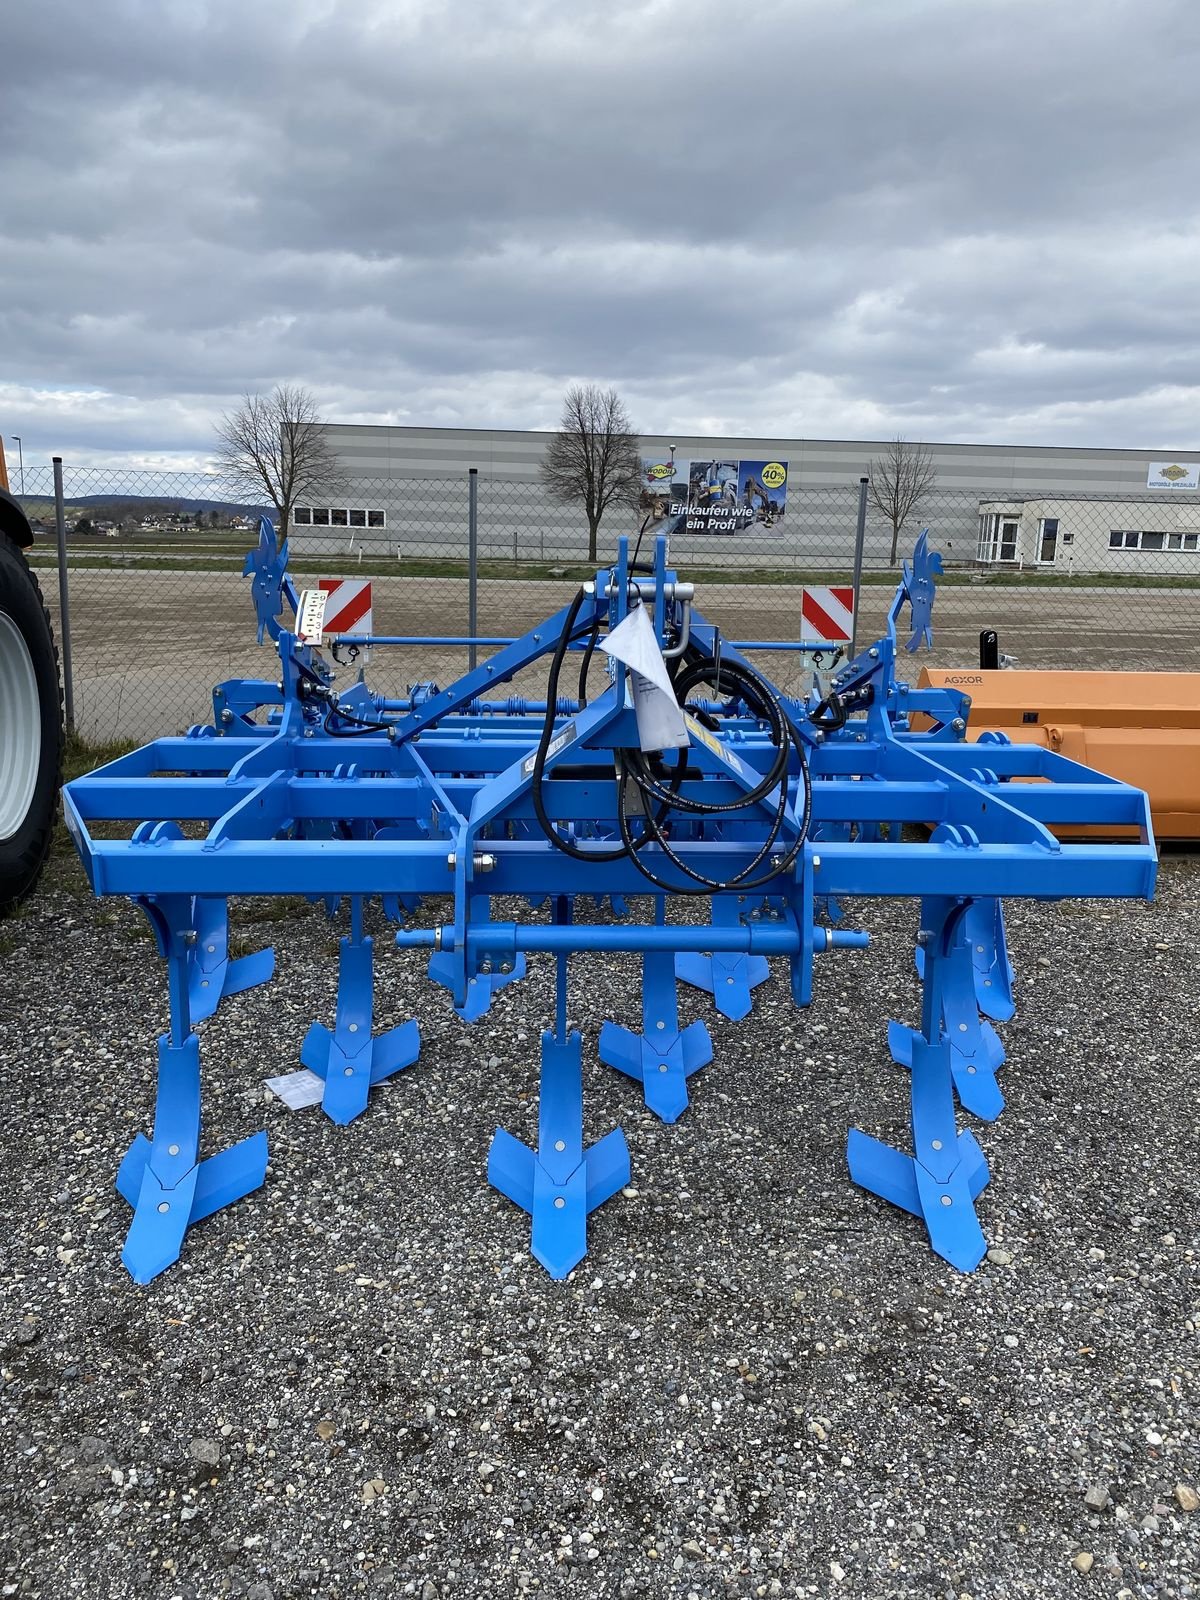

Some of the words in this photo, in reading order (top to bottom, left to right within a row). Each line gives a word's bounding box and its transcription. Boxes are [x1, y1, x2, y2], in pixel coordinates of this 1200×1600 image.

[763, 470, 784, 480] 40%
[670, 503, 728, 516] Einkaufen
[731, 505, 753, 517] wie
[686, 517, 705, 529] ein
[707, 518, 736, 530] Profi
[944, 676, 983, 684] AGXOR
